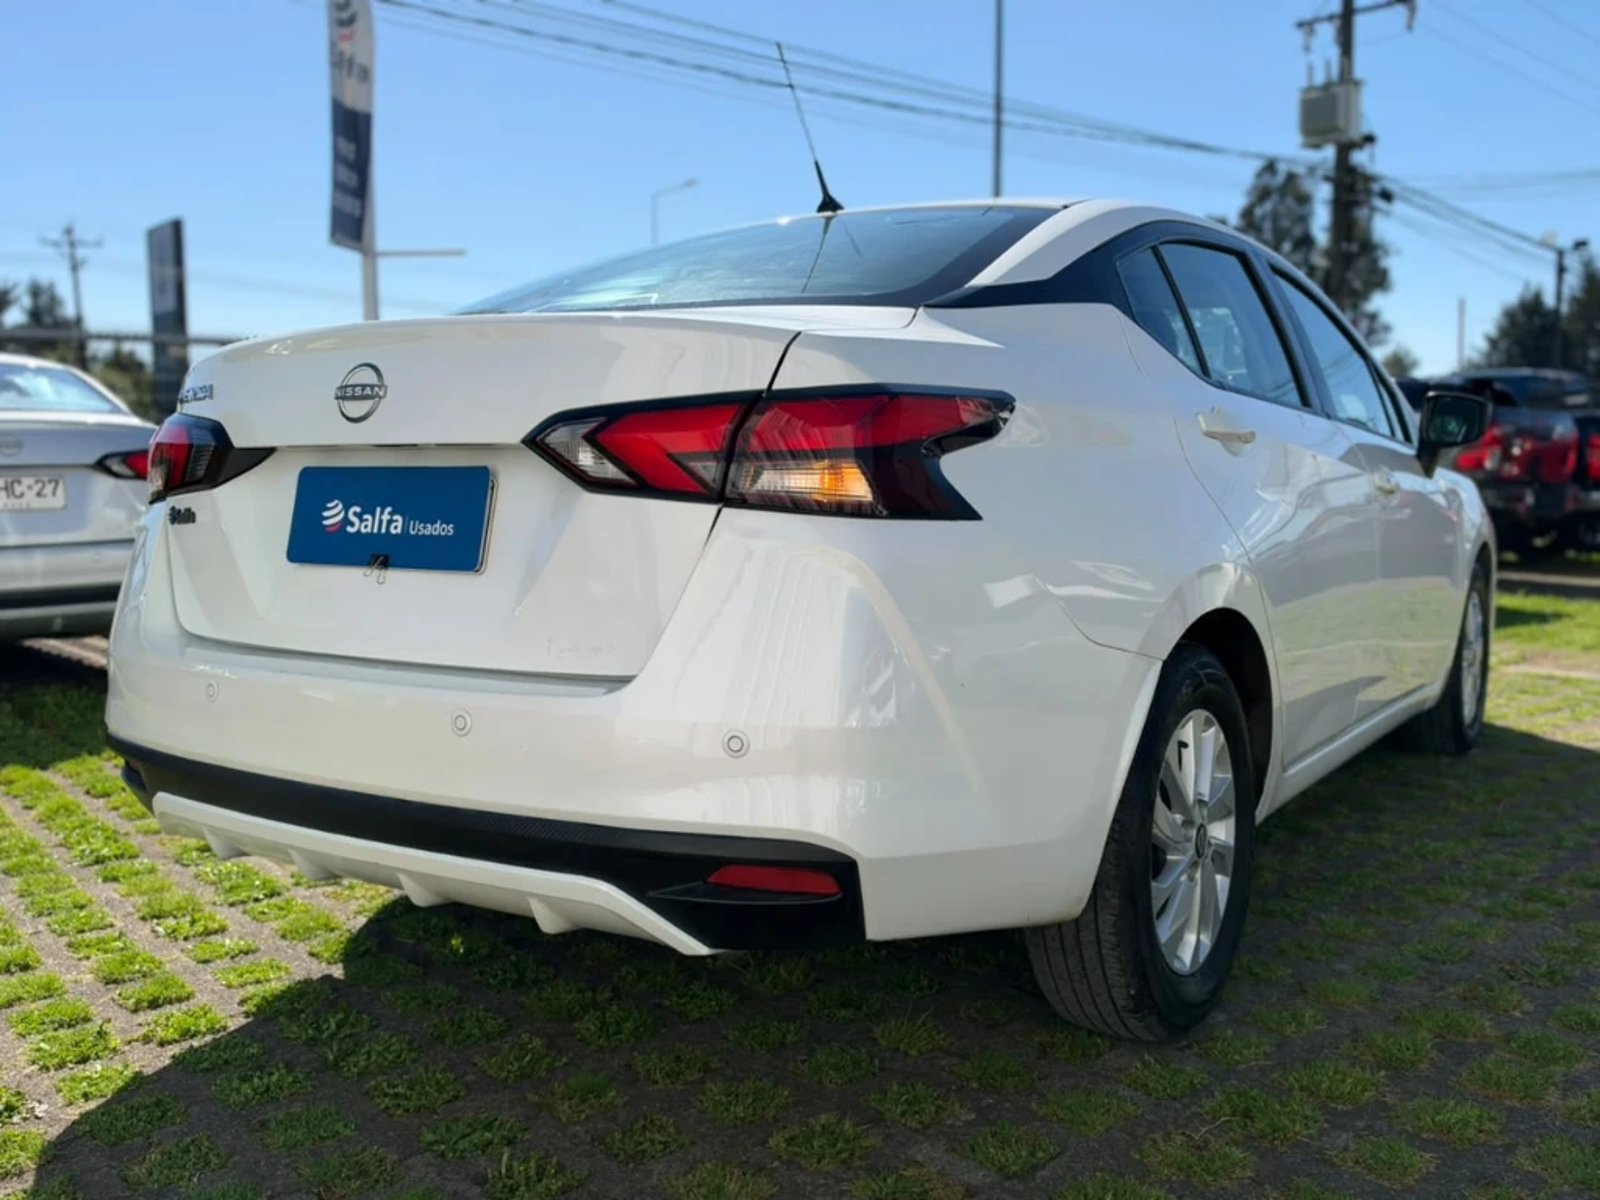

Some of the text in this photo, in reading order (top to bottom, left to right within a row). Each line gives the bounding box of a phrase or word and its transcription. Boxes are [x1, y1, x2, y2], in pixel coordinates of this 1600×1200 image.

[336, 385, 386, 398] NISSAN
[346, 505, 455, 537] Salfa Usados
